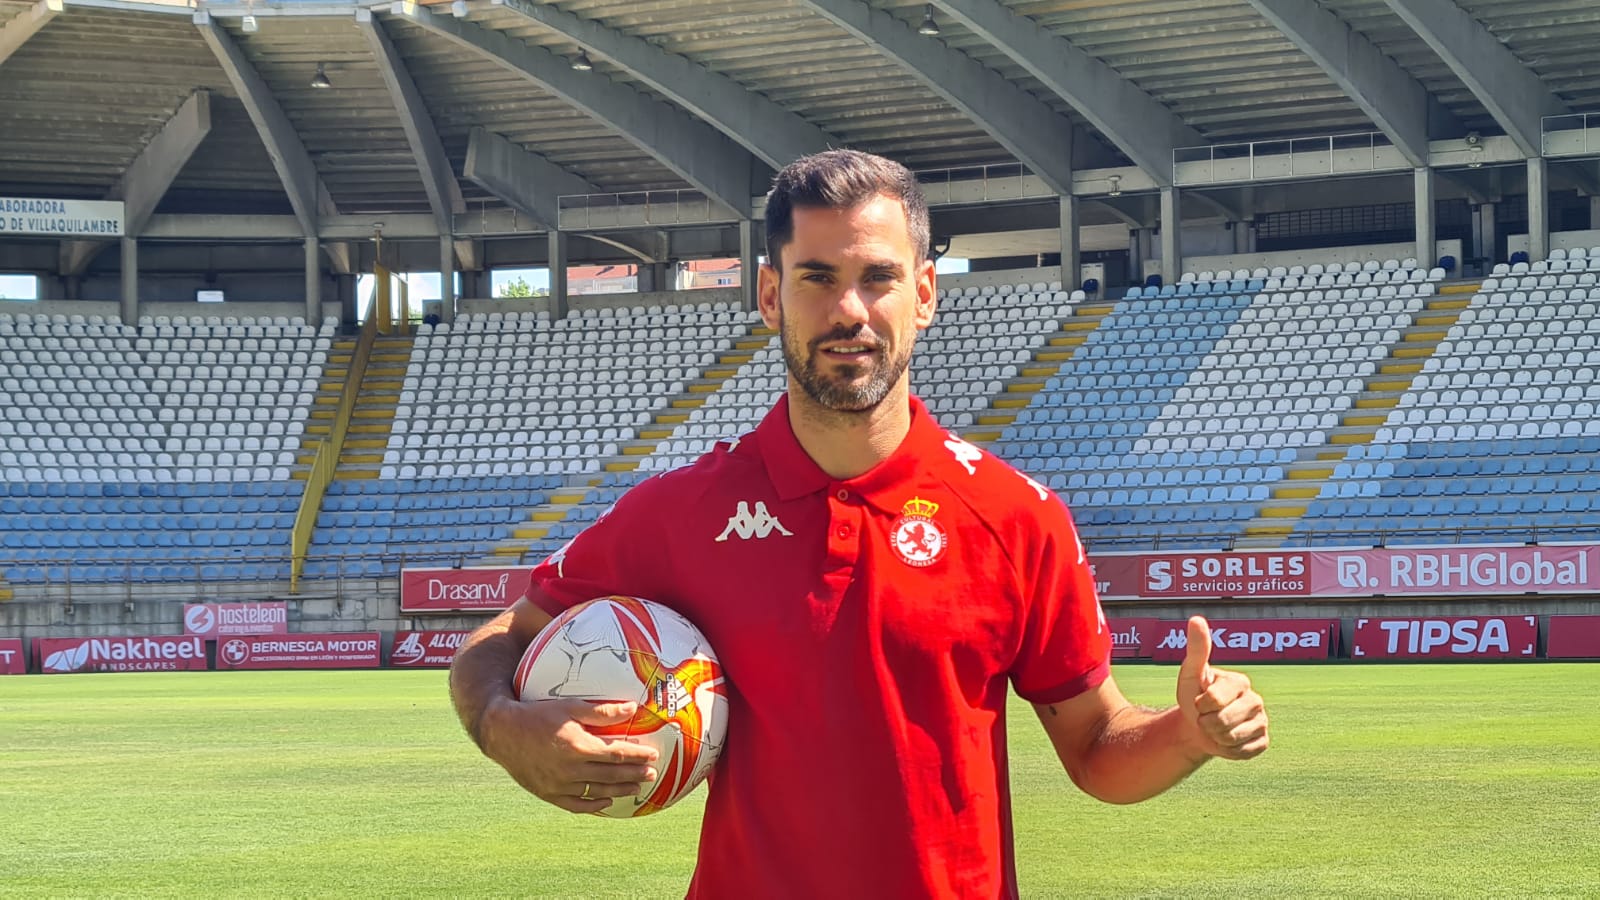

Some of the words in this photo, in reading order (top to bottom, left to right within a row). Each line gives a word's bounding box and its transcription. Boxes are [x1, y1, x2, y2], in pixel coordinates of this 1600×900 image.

[11, 217, 23, 231] DE
[28, 218, 119, 233] VILLAQUILAMBRE
[1182, 556, 1305, 577] SORLES
[1391, 551, 1588, 587] RBHGlobal
[428, 573, 509, 600] Drasanvi
[1183, 579, 1243, 593] servicios
[1247, 577, 1304, 594] gráficos
[218, 603, 286, 625] hosteleón
[252, 641, 325, 653] BERNESGA
[327, 640, 377, 652] MOTOR
[1210, 628, 1321, 652] Kappa
[1380, 619, 1510, 653] TIPSA
[90, 637, 205, 660] Nakheel
[92, 661, 177, 671] LANDSCAPES
[666, 673, 676, 718] adidas
